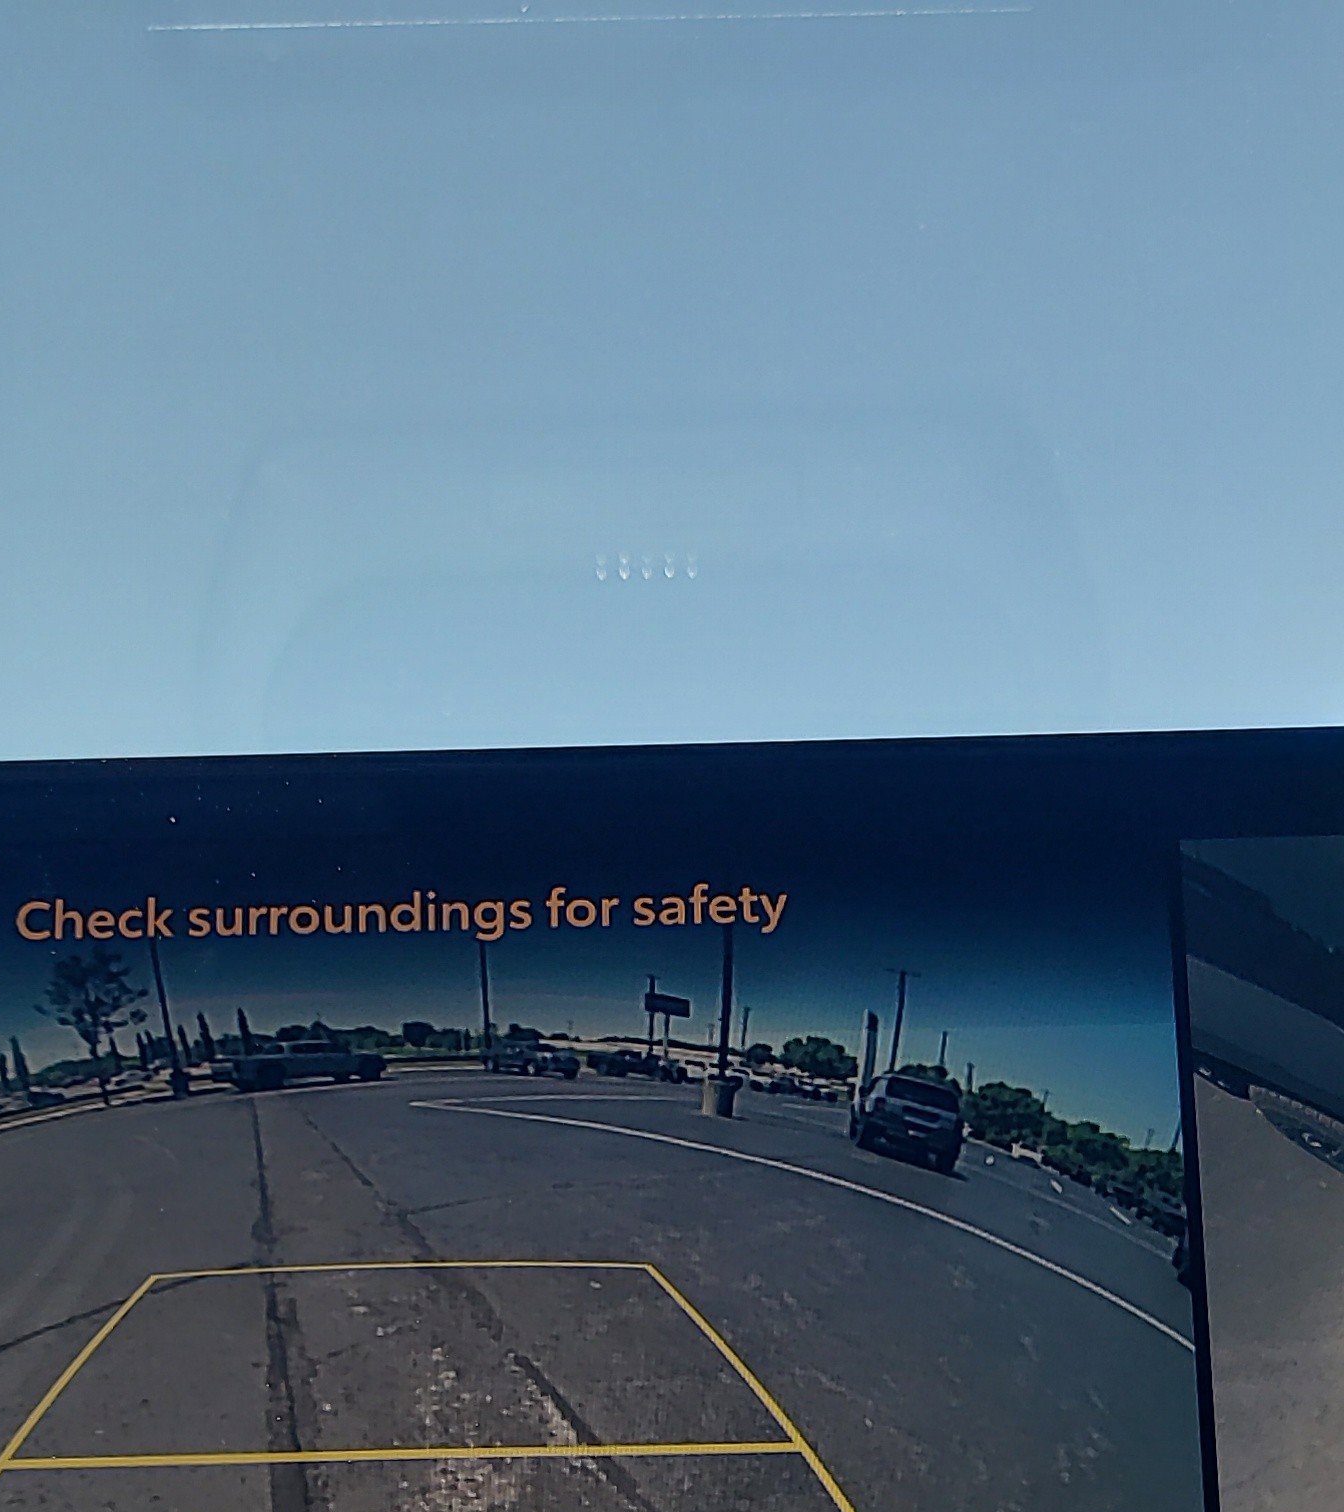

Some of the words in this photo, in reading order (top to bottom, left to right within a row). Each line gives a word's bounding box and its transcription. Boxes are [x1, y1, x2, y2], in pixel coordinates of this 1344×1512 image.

[16, 896, 173, 941] Check
[187, 889, 533, 942] surroundings
[545, 886, 620, 929] for
[632, 883, 789, 935] safety
